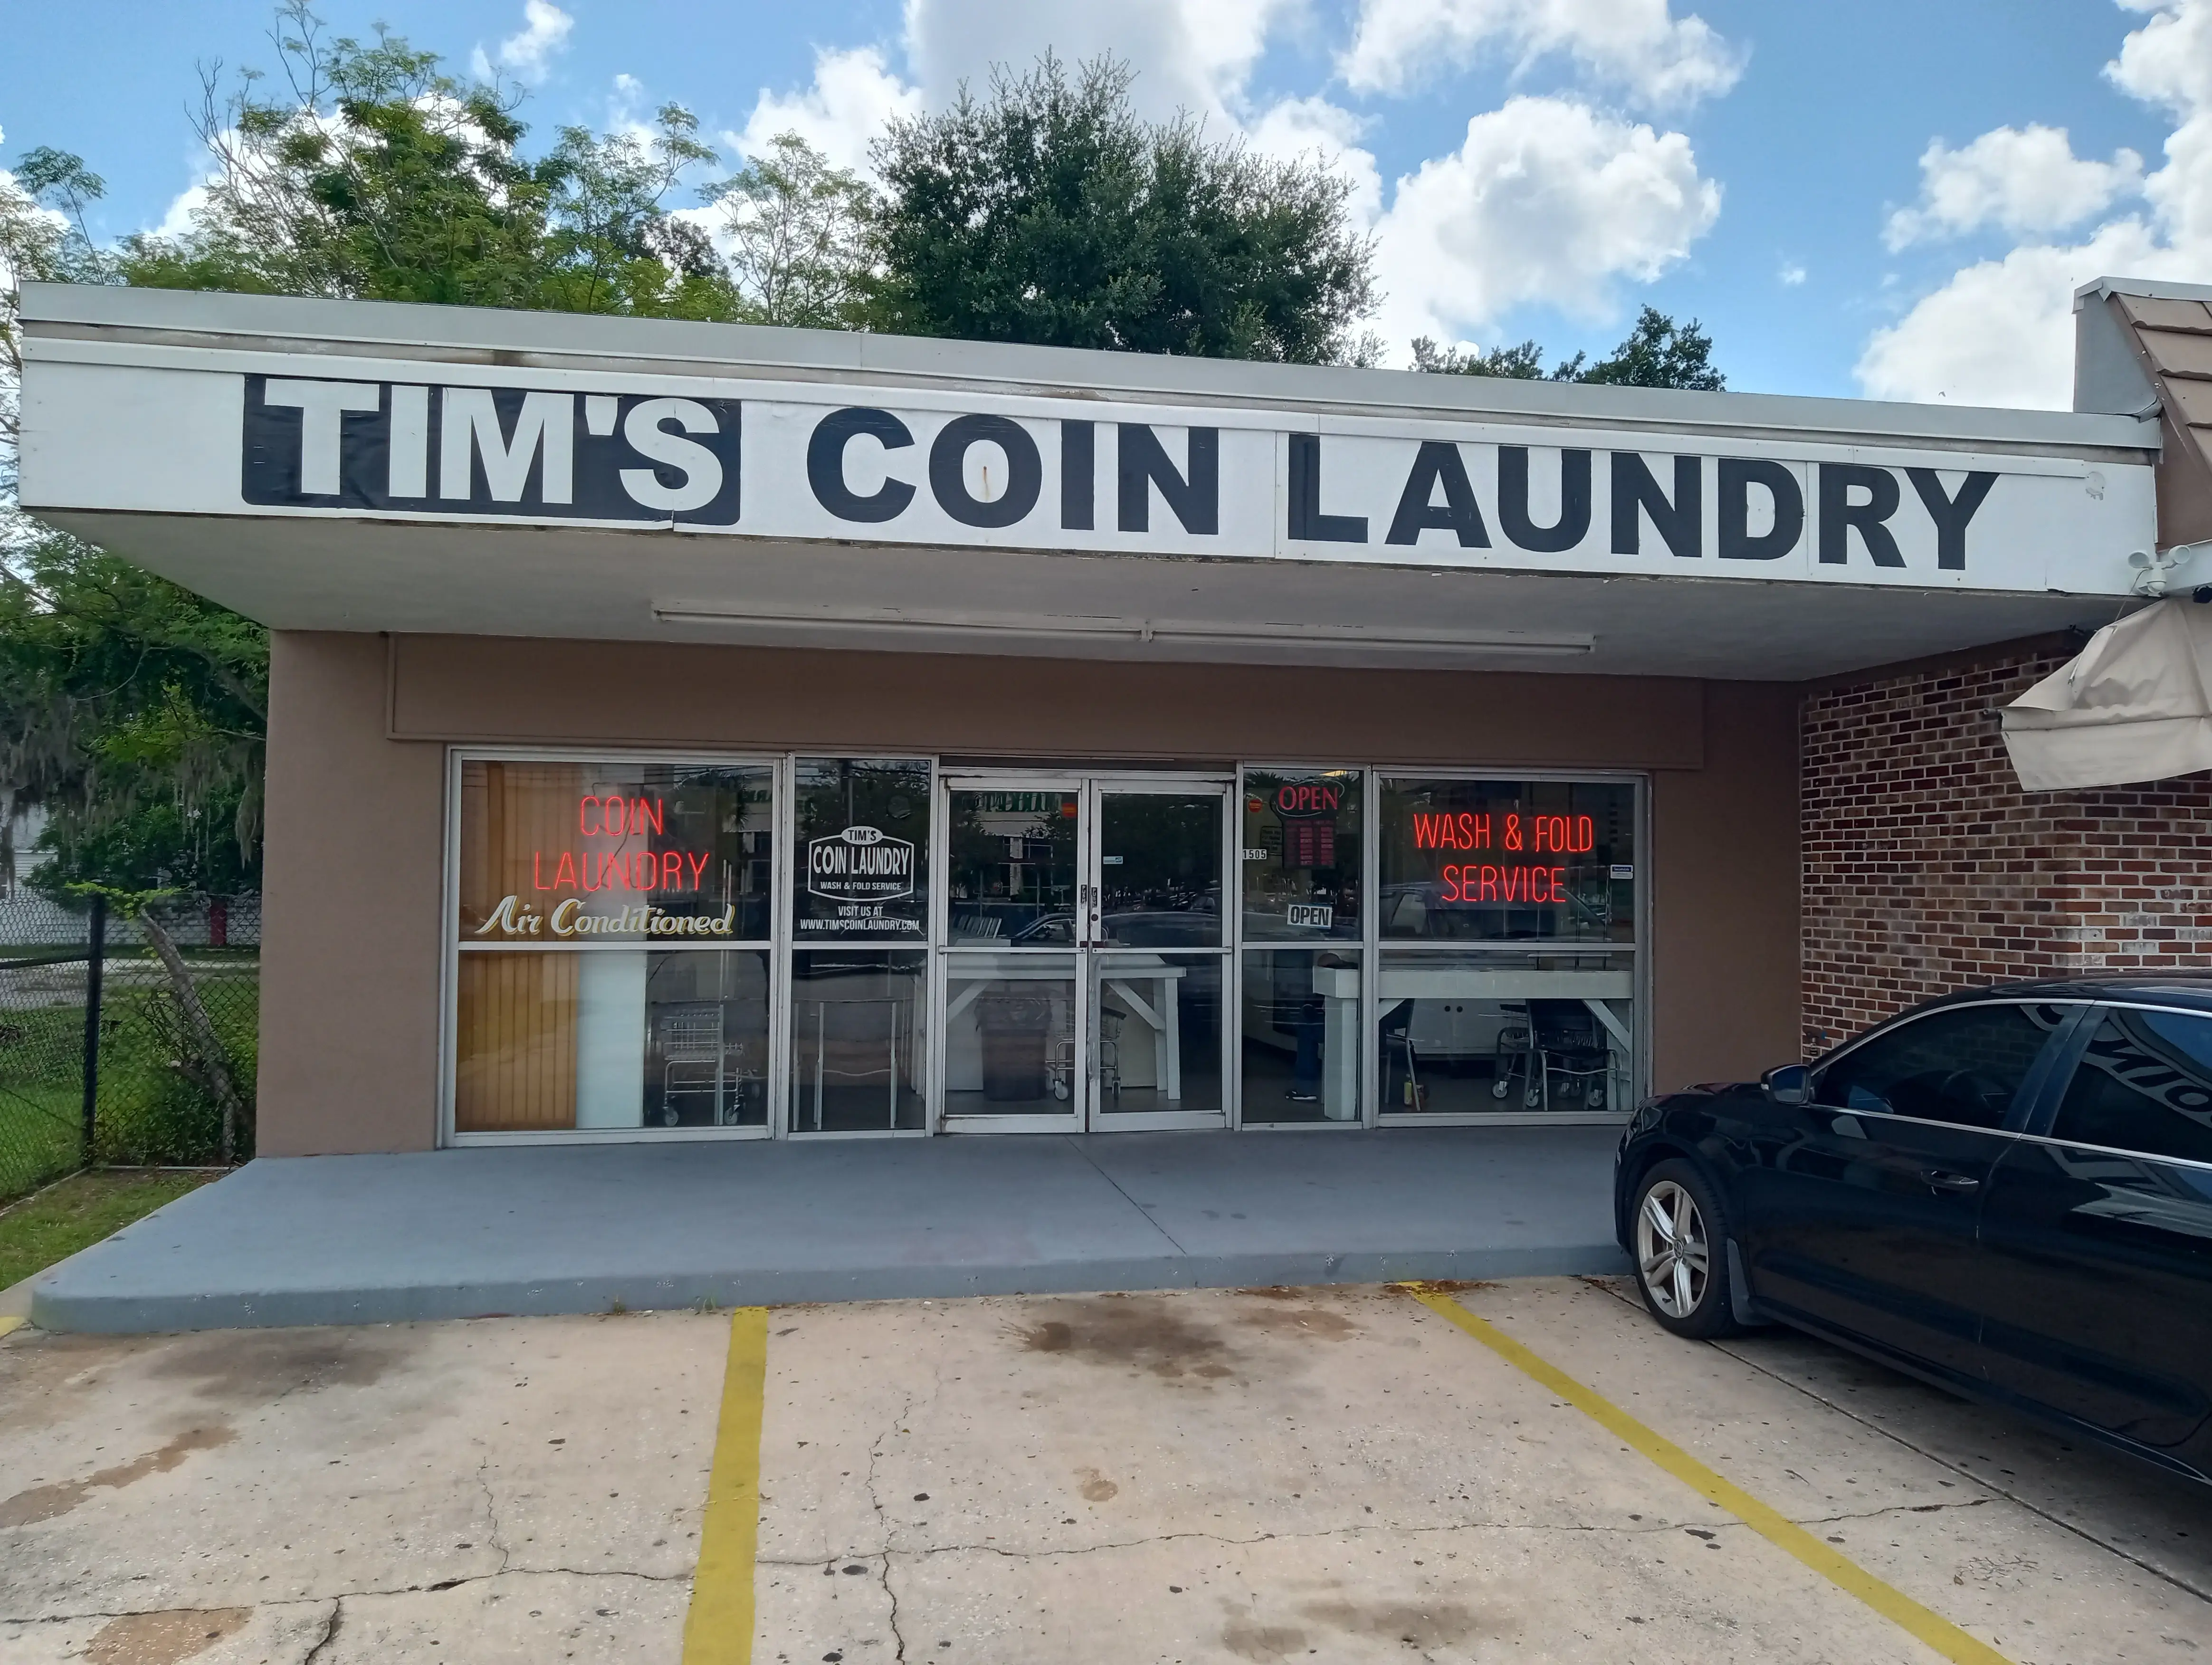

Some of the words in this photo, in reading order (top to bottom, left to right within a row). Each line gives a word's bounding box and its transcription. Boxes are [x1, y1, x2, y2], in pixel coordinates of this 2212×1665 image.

[264, 378, 723, 512] TIM'S
[806, 407, 1219, 535] COIN
[1288, 433, 1999, 570] LAUNDRY
[1278, 786, 1338, 810] OPEN
[580, 795, 664, 836] COIN
[848, 830, 877, 841] TIM'S
[1413, 813, 1490, 849] WASH
[1505, 813, 1523, 851] &
[1535, 814, 1593, 852] FOLD
[813, 845, 846, 874] COIN
[850, 846, 910, 875] LAUNDRY
[1243, 850, 1266, 859] 1505
[534, 851, 710, 892] LAUNDRY
[1442, 865, 1566, 903] SERVICE
[820, 881, 841, 890] WASH
[844, 882, 850, 890] &
[853, 882, 870, 890] FOLD
[475, 895, 543, 935] Air
[551, 898, 736, 936] Conditioned
[800, 919, 919, 930] WWW.TIMSCOINLAUNDRY.COM
[838, 906, 858, 916] VISIT
[860, 906, 871, 917] US
[873, 906, 883, 917] AT
[1290, 906, 1329, 926] OPEN
